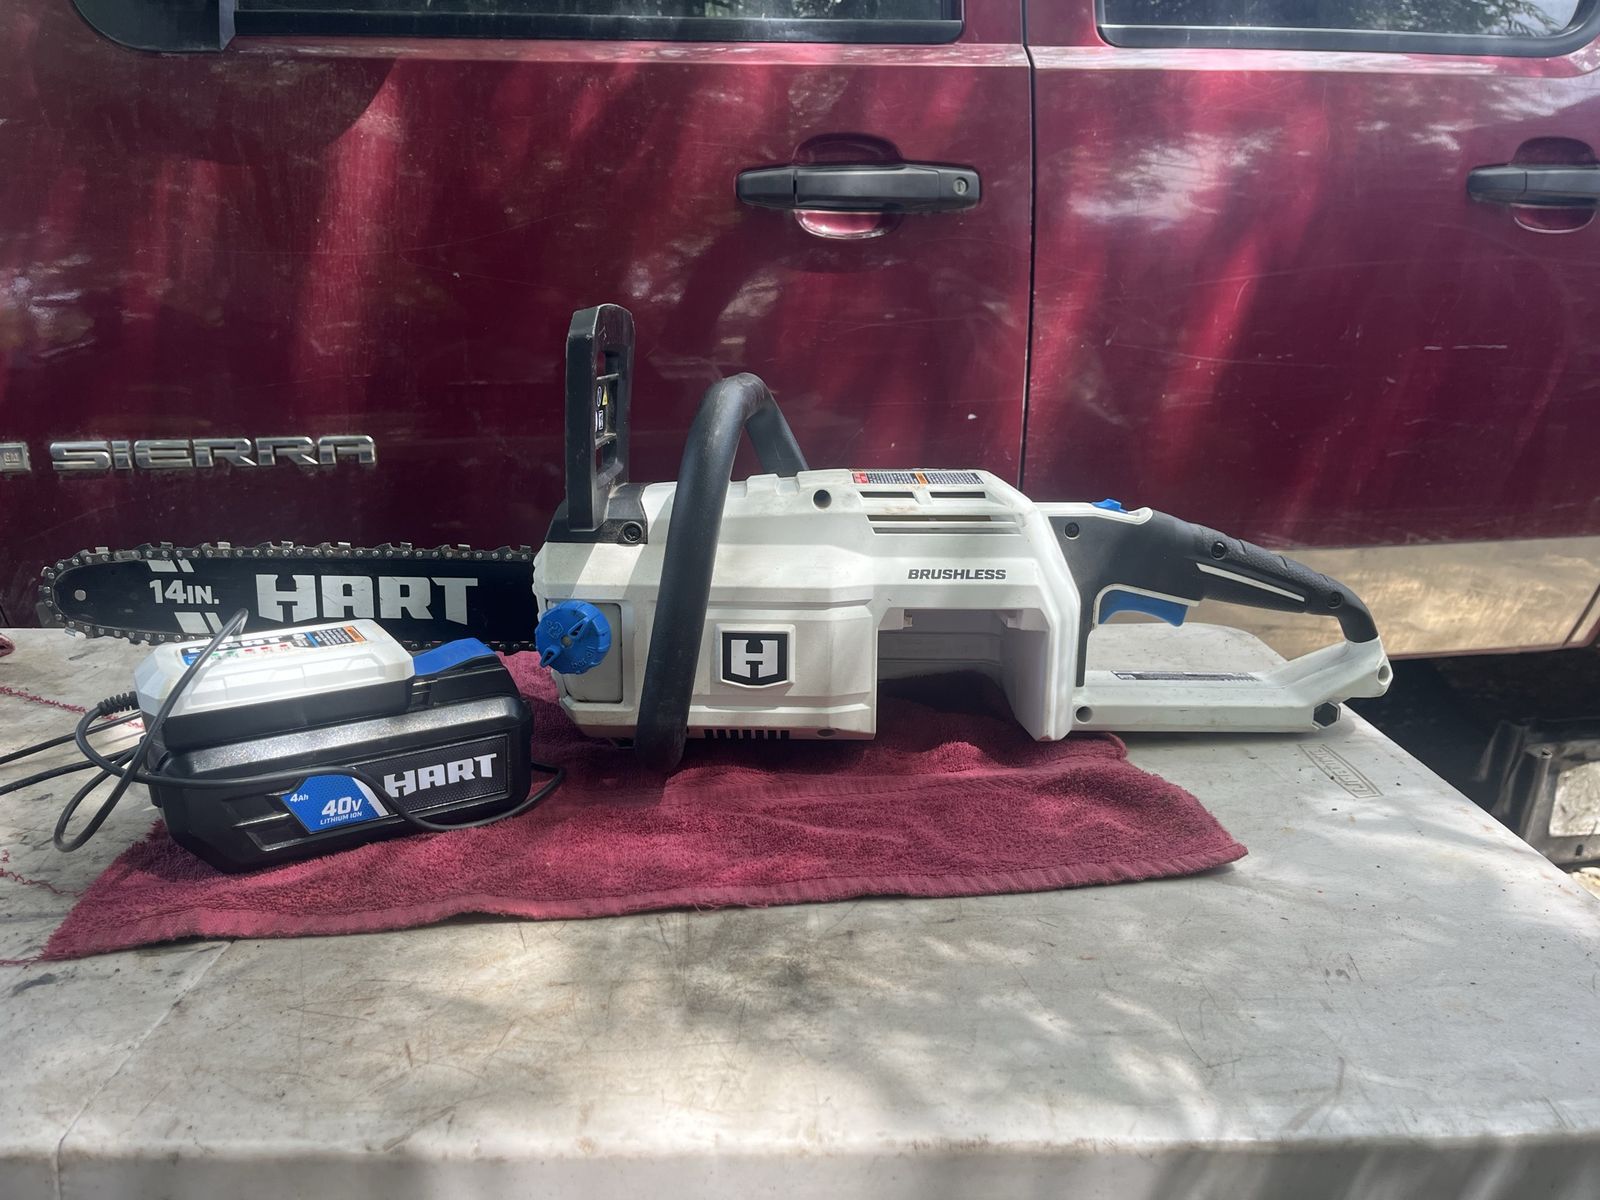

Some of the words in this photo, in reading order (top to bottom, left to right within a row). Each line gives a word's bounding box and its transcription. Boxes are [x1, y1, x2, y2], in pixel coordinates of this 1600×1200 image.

[50, 435, 376, 470] SIERRA
[907, 568, 1007, 580] BRUSHLESS
[149, 579, 220, 605] 14IN.
[255, 574, 478, 625] HART
[731, 639, 778, 679] H
[383, 752, 497, 798] HART
[289, 793, 309, 803] 4Ah
[320, 814, 349, 825] LITHIUM
[349, 811, 363, 819] ION
